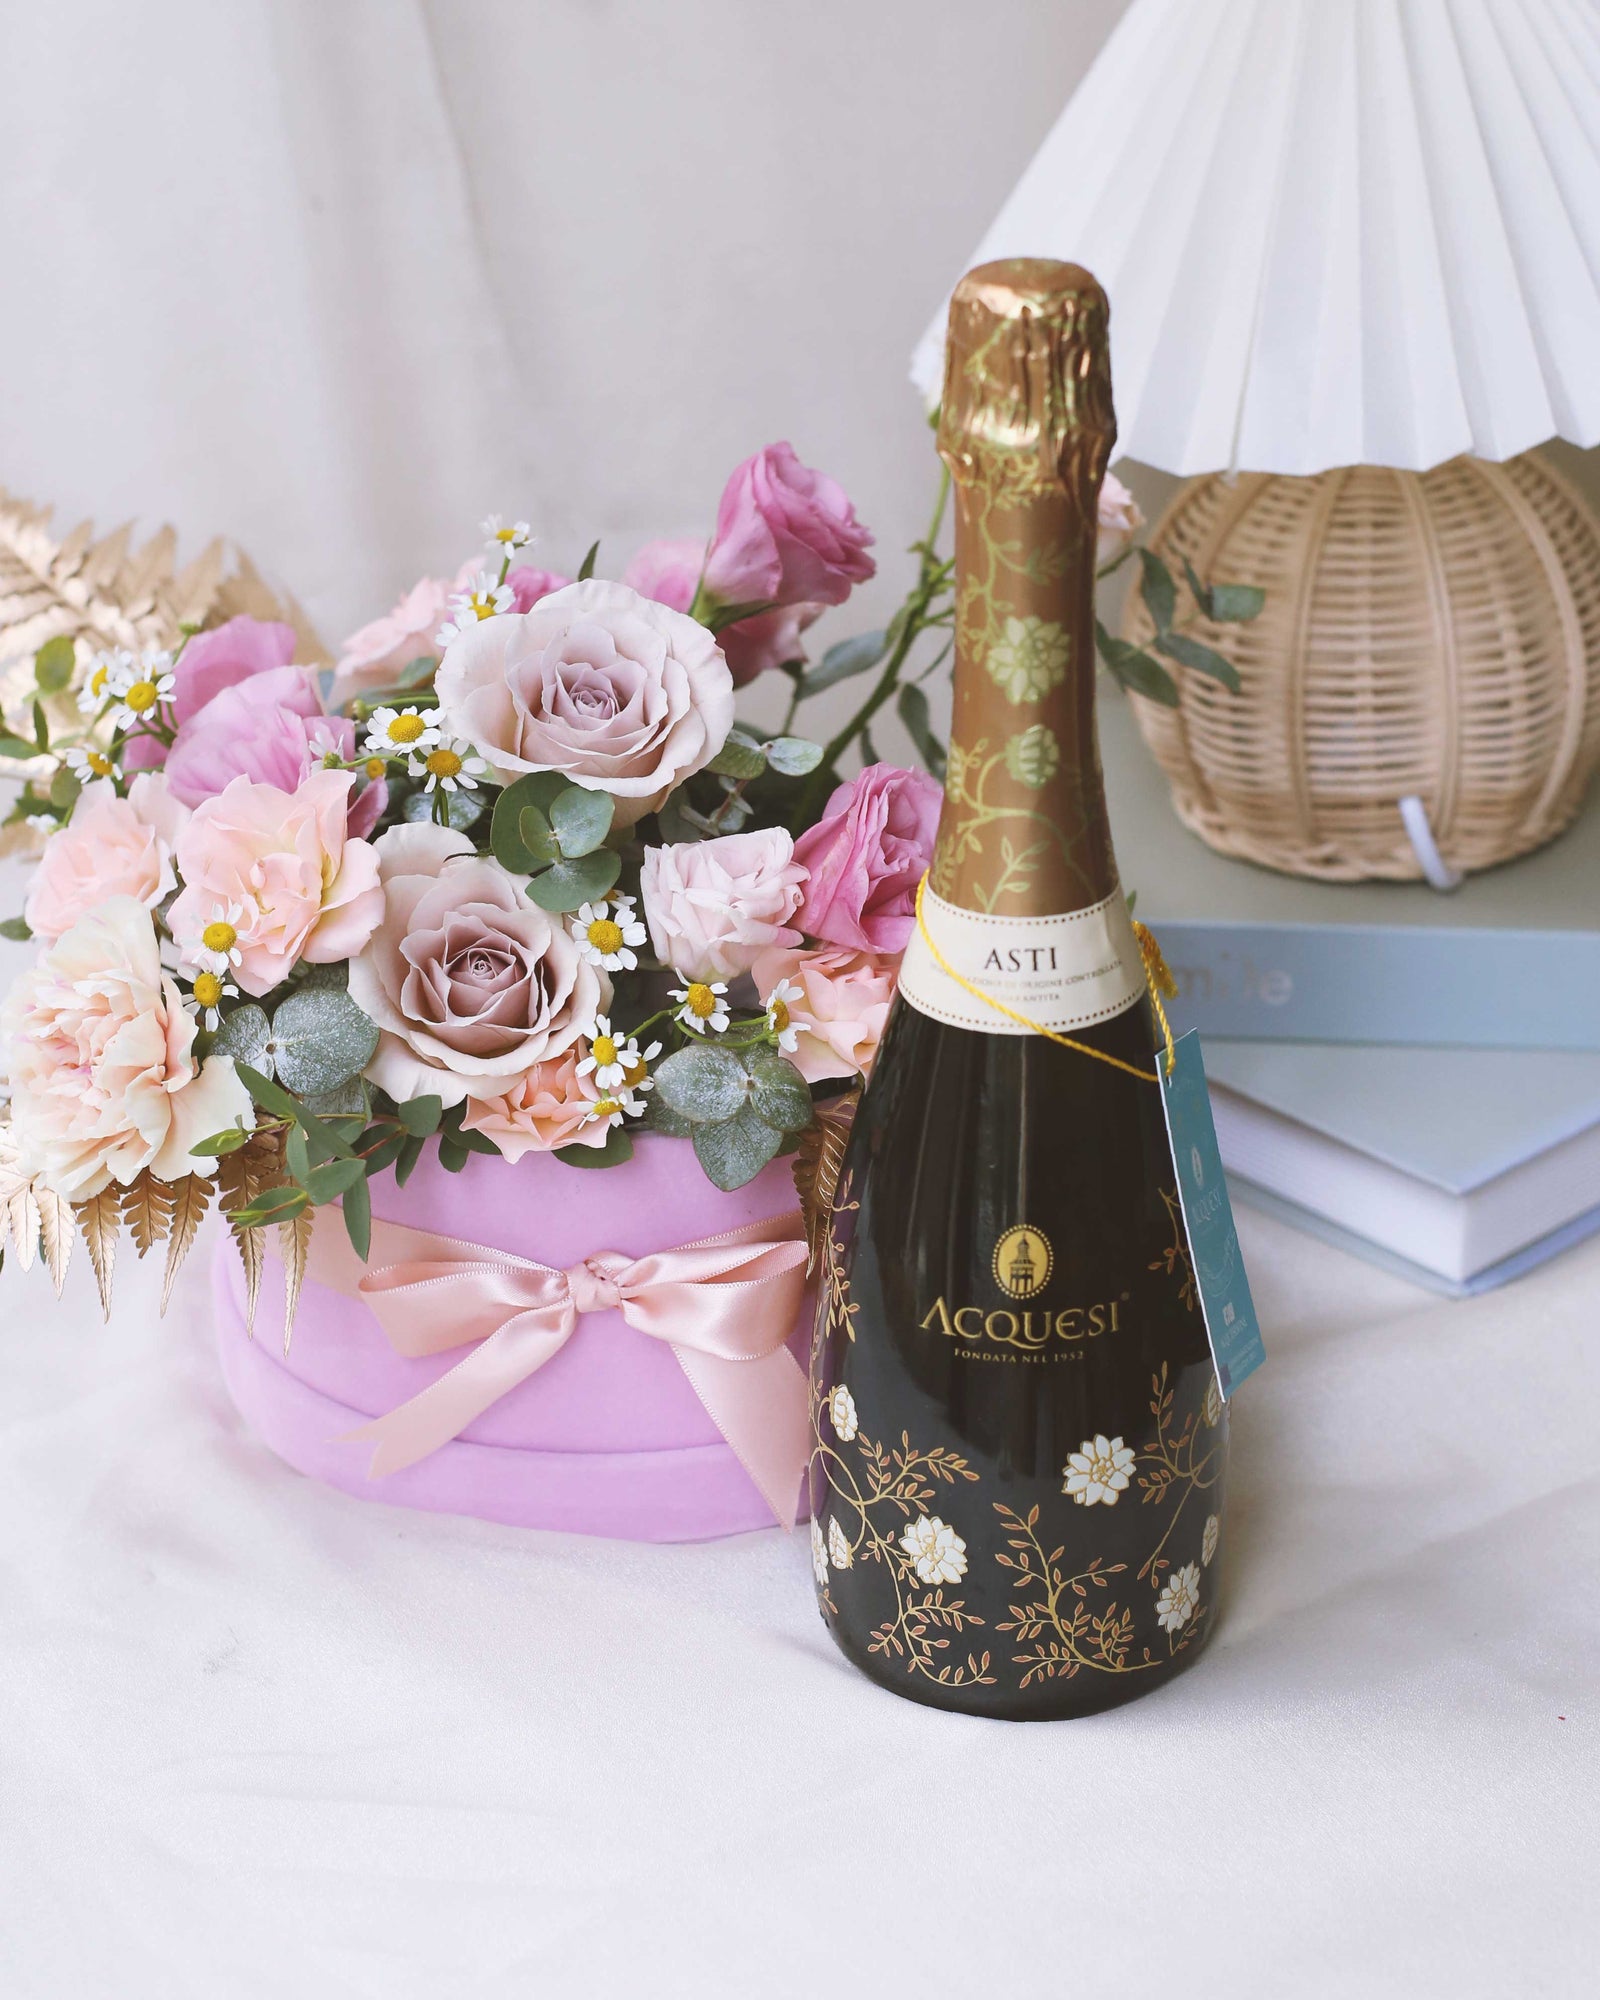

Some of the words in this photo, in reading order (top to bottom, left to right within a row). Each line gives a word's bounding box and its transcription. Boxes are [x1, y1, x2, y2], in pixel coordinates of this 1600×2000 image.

[984, 947, 1058, 973] ASTI
[918, 1296, 1120, 1350] ACQUESI
[954, 1348, 1017, 1364] FONDATA
[1022, 1355, 1048, 1364] NEL
[1053, 1350, 1085, 1363] 1952
